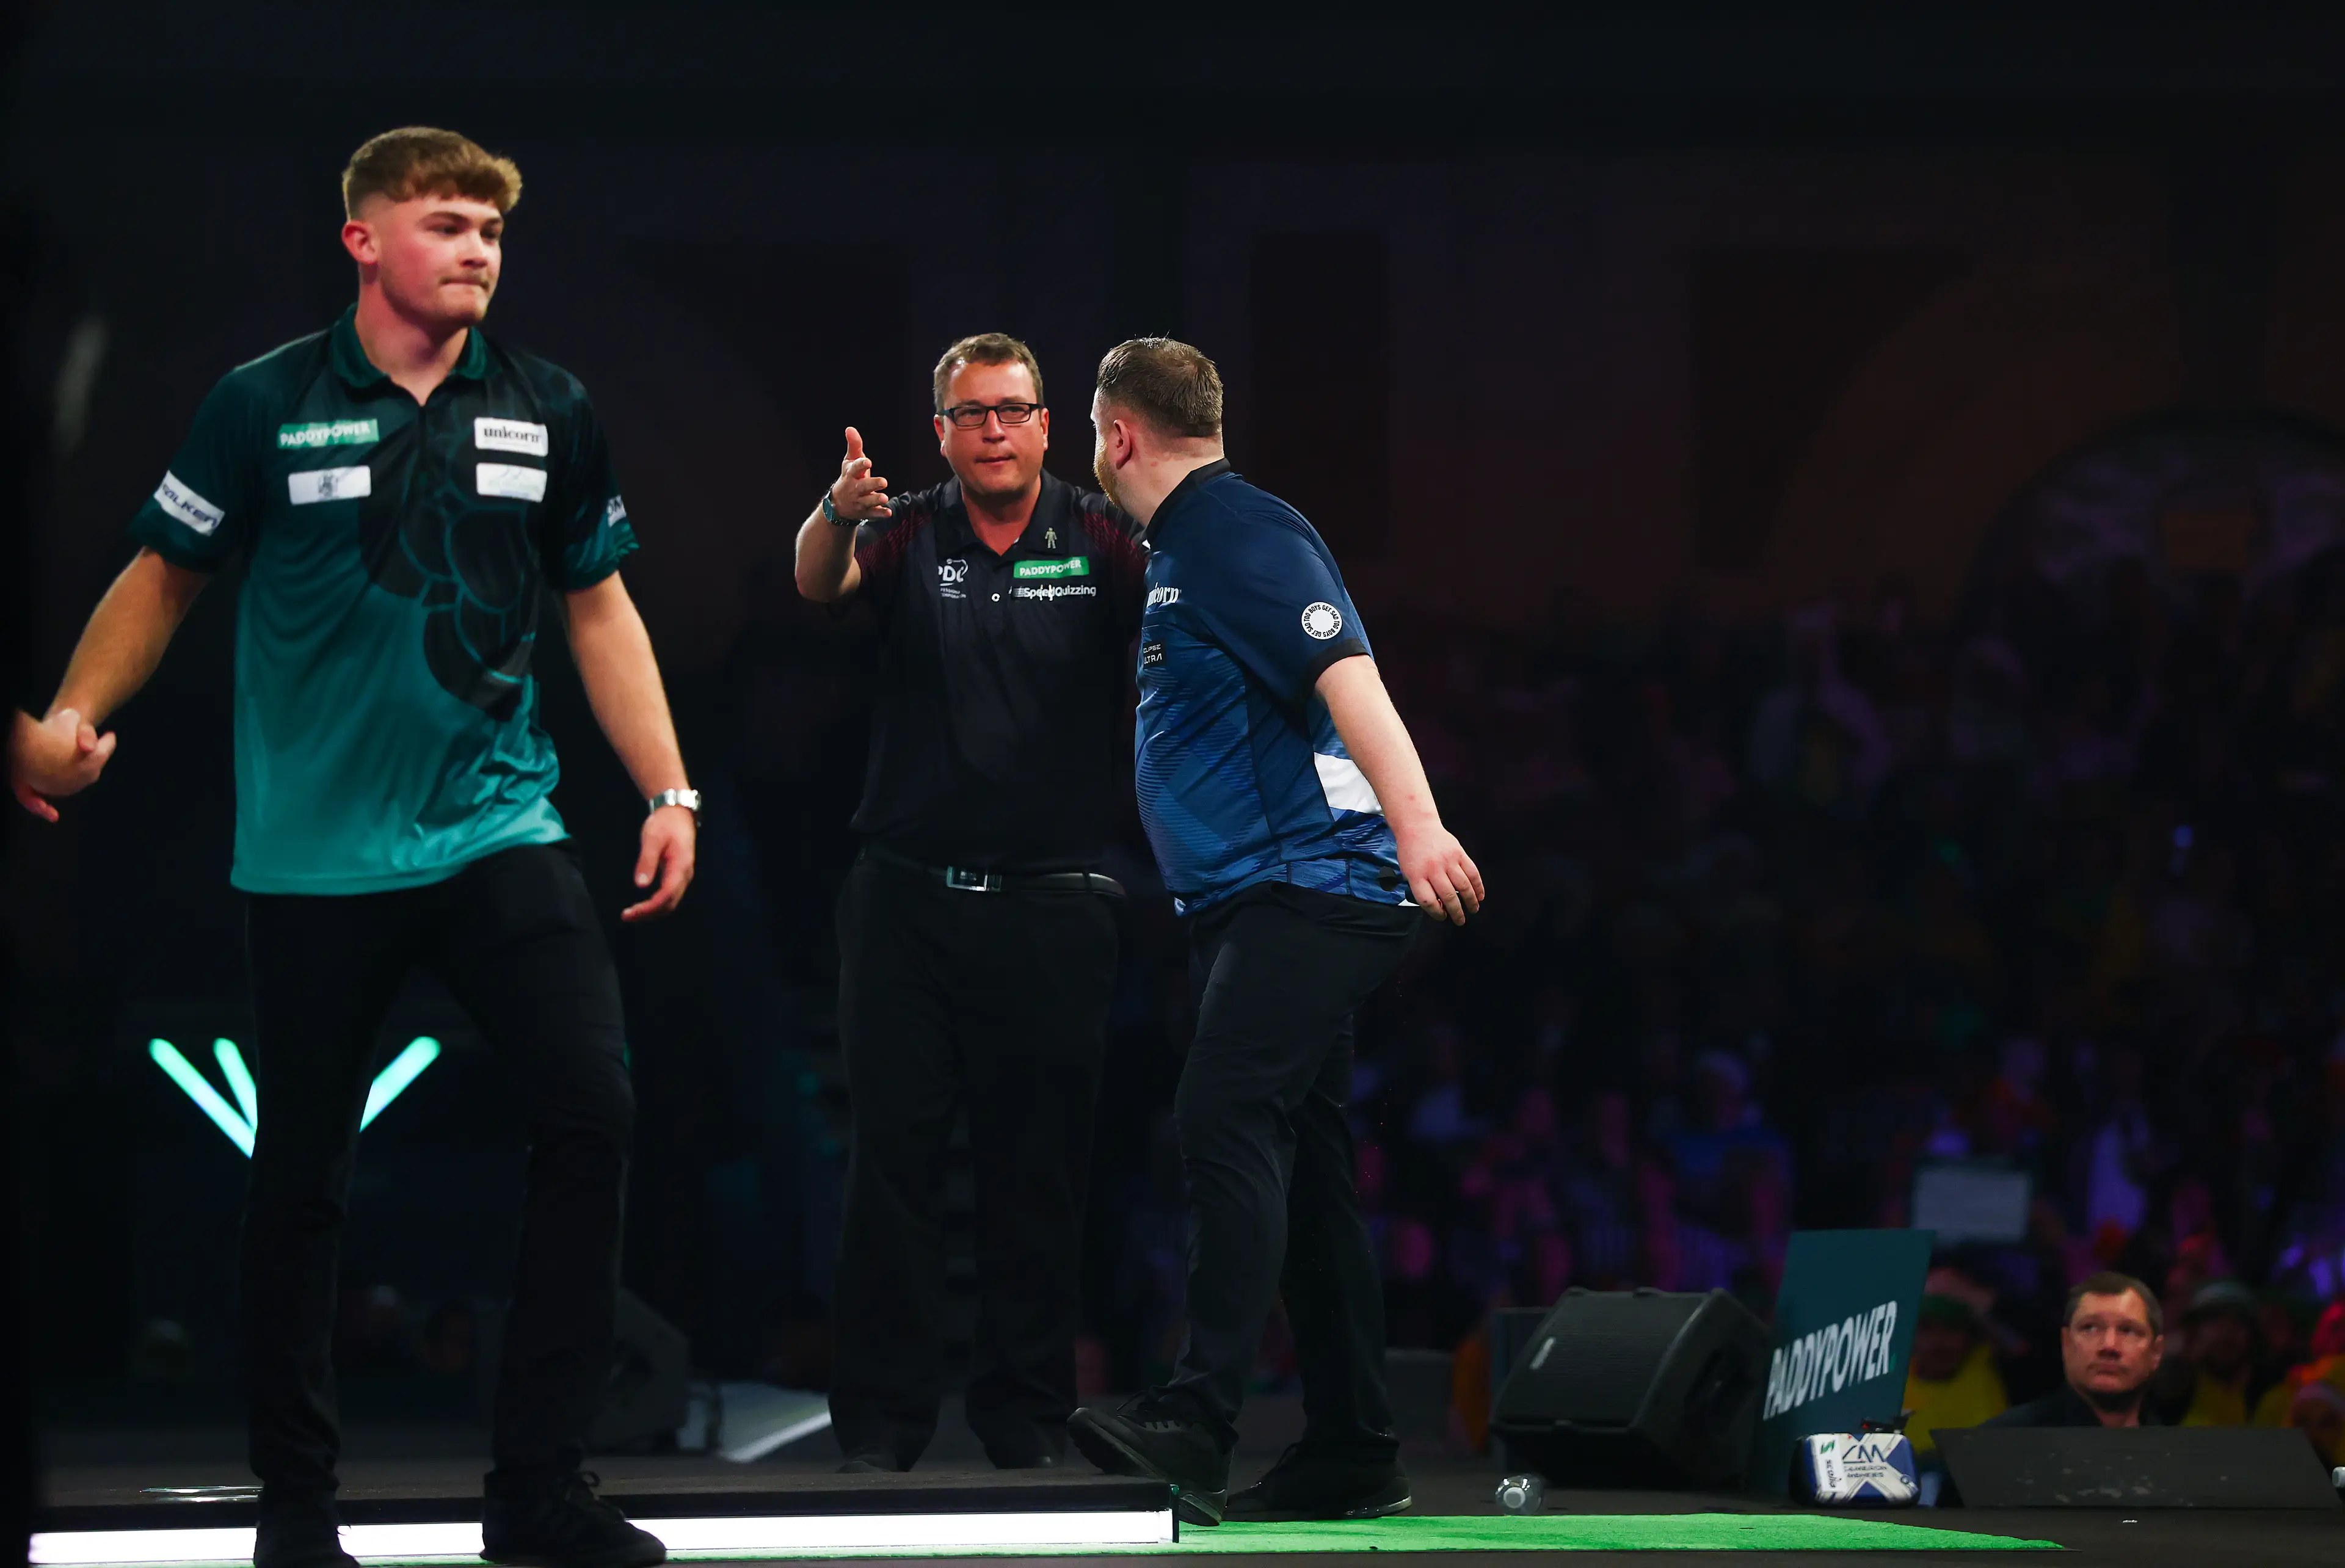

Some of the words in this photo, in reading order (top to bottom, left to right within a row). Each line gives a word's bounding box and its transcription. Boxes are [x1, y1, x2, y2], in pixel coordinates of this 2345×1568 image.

[280, 421, 370, 446] PADDYPOWER
[484, 426, 540, 443] unicorn
[1019, 558, 1082, 576] PADDYPOWER
[1308, 604, 1321, 613] BOYS
[1330, 611, 1339, 620] SAD
[1304, 622, 1314, 632] SAD
[1322, 628, 1336, 637] BOYS
[1763, 1300, 1897, 1421] PADDYPOWER
